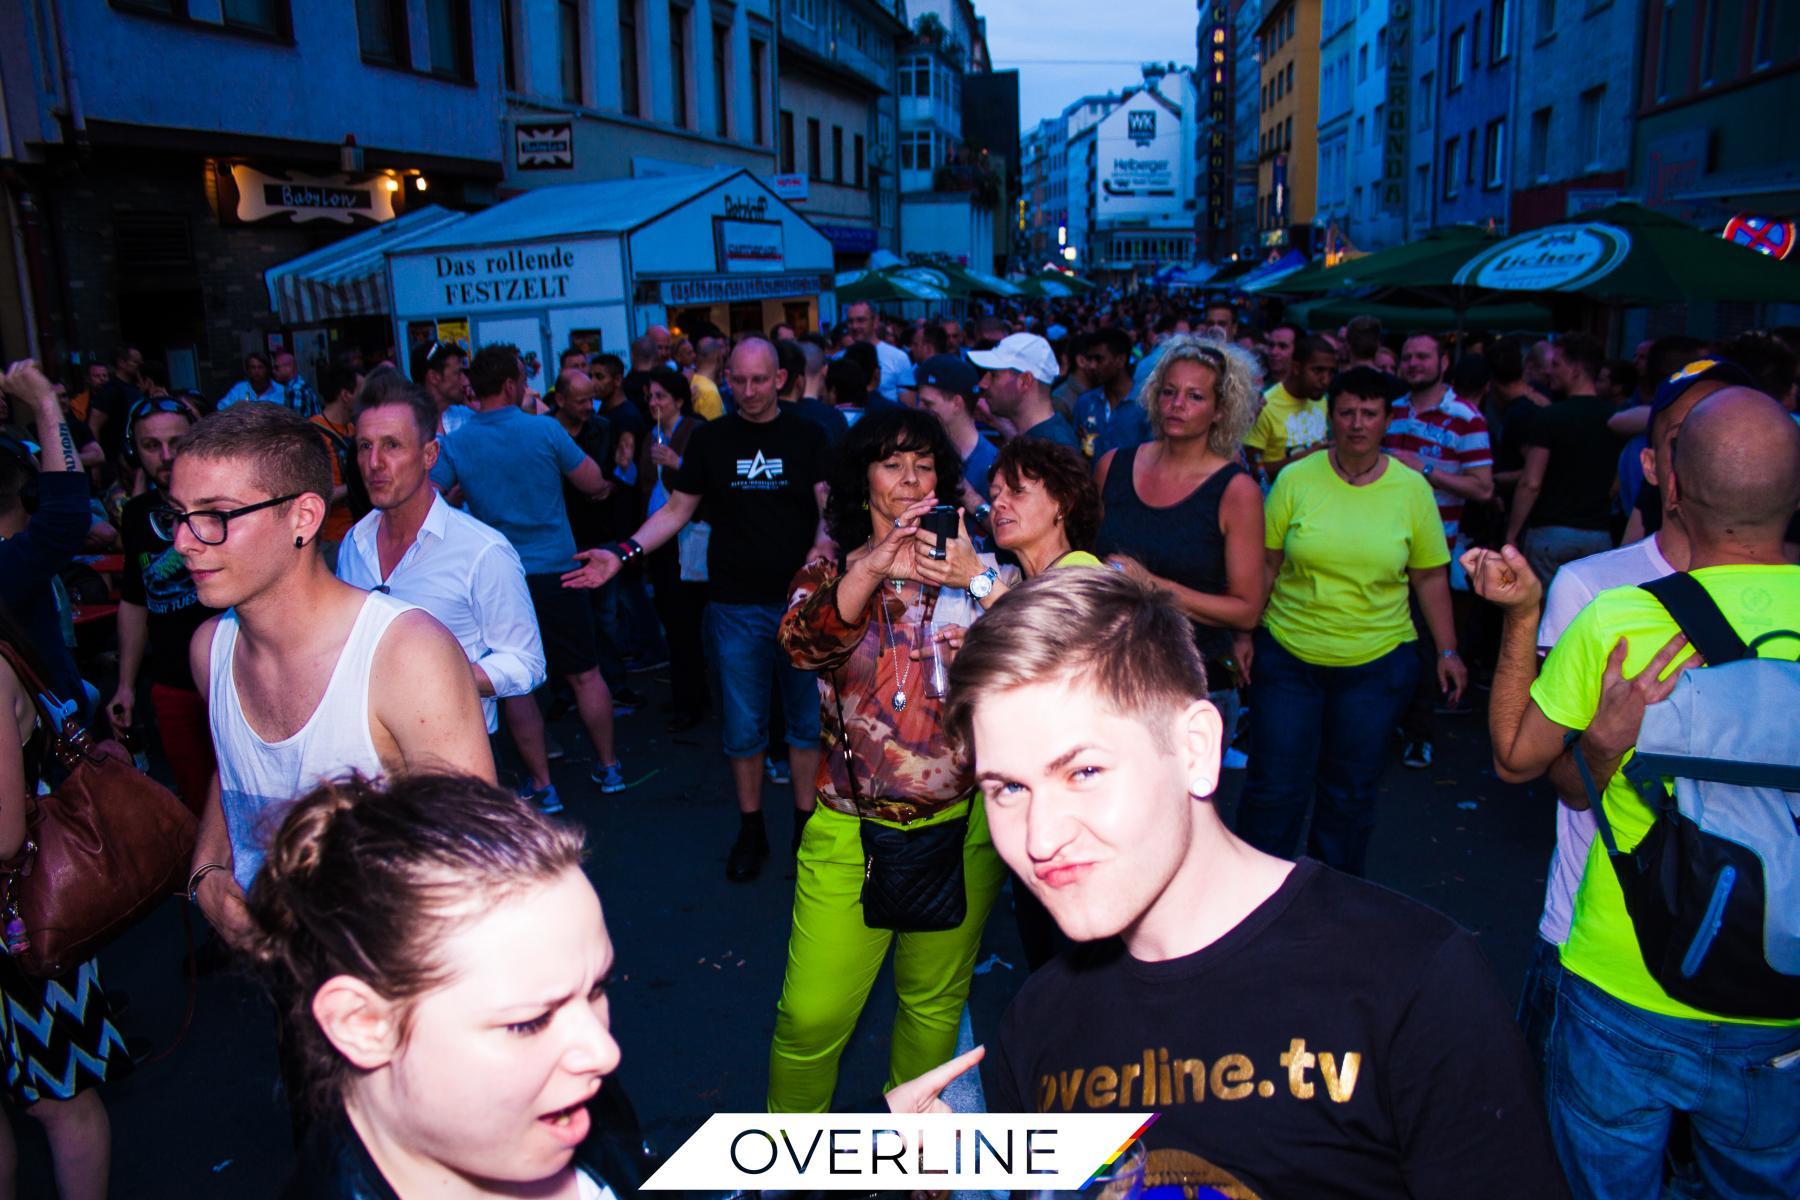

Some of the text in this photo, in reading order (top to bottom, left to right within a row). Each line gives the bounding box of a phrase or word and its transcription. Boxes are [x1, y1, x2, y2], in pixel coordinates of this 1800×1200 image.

[436, 246, 574, 277] Das rollende
[1494, 251, 1591, 270] Licher
[446, 275, 569, 305] FESTZELT
